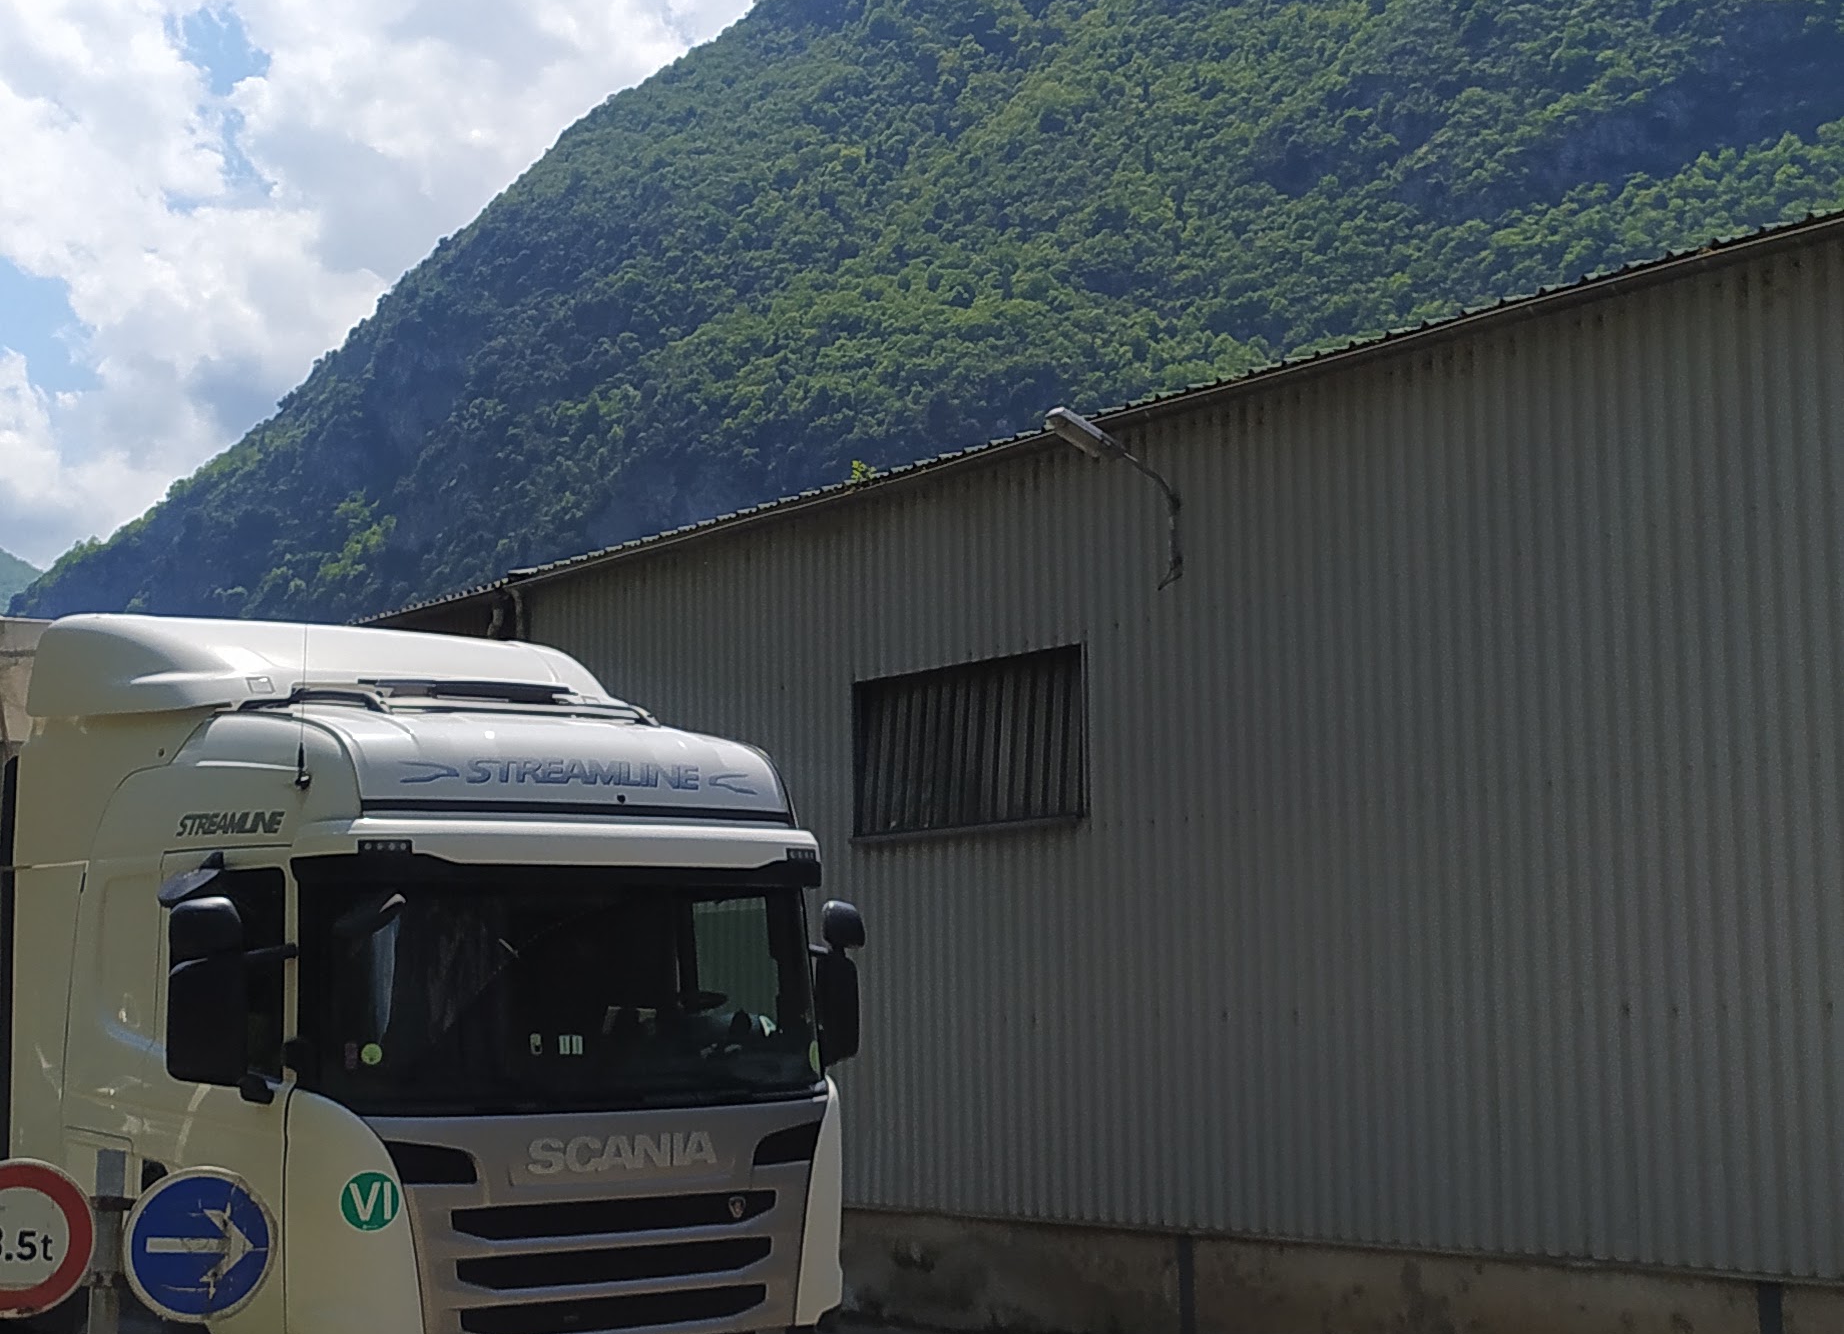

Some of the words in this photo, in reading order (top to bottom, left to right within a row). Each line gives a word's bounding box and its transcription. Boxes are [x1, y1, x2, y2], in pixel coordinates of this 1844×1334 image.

[465, 758, 699, 791] STREAMLINE
[176, 811, 286, 837] STREAMLINE
[527, 1131, 718, 1174] SCANIA
[349, 1181, 392, 1221] VI
[0, 1227, 53, 1262] .5t
